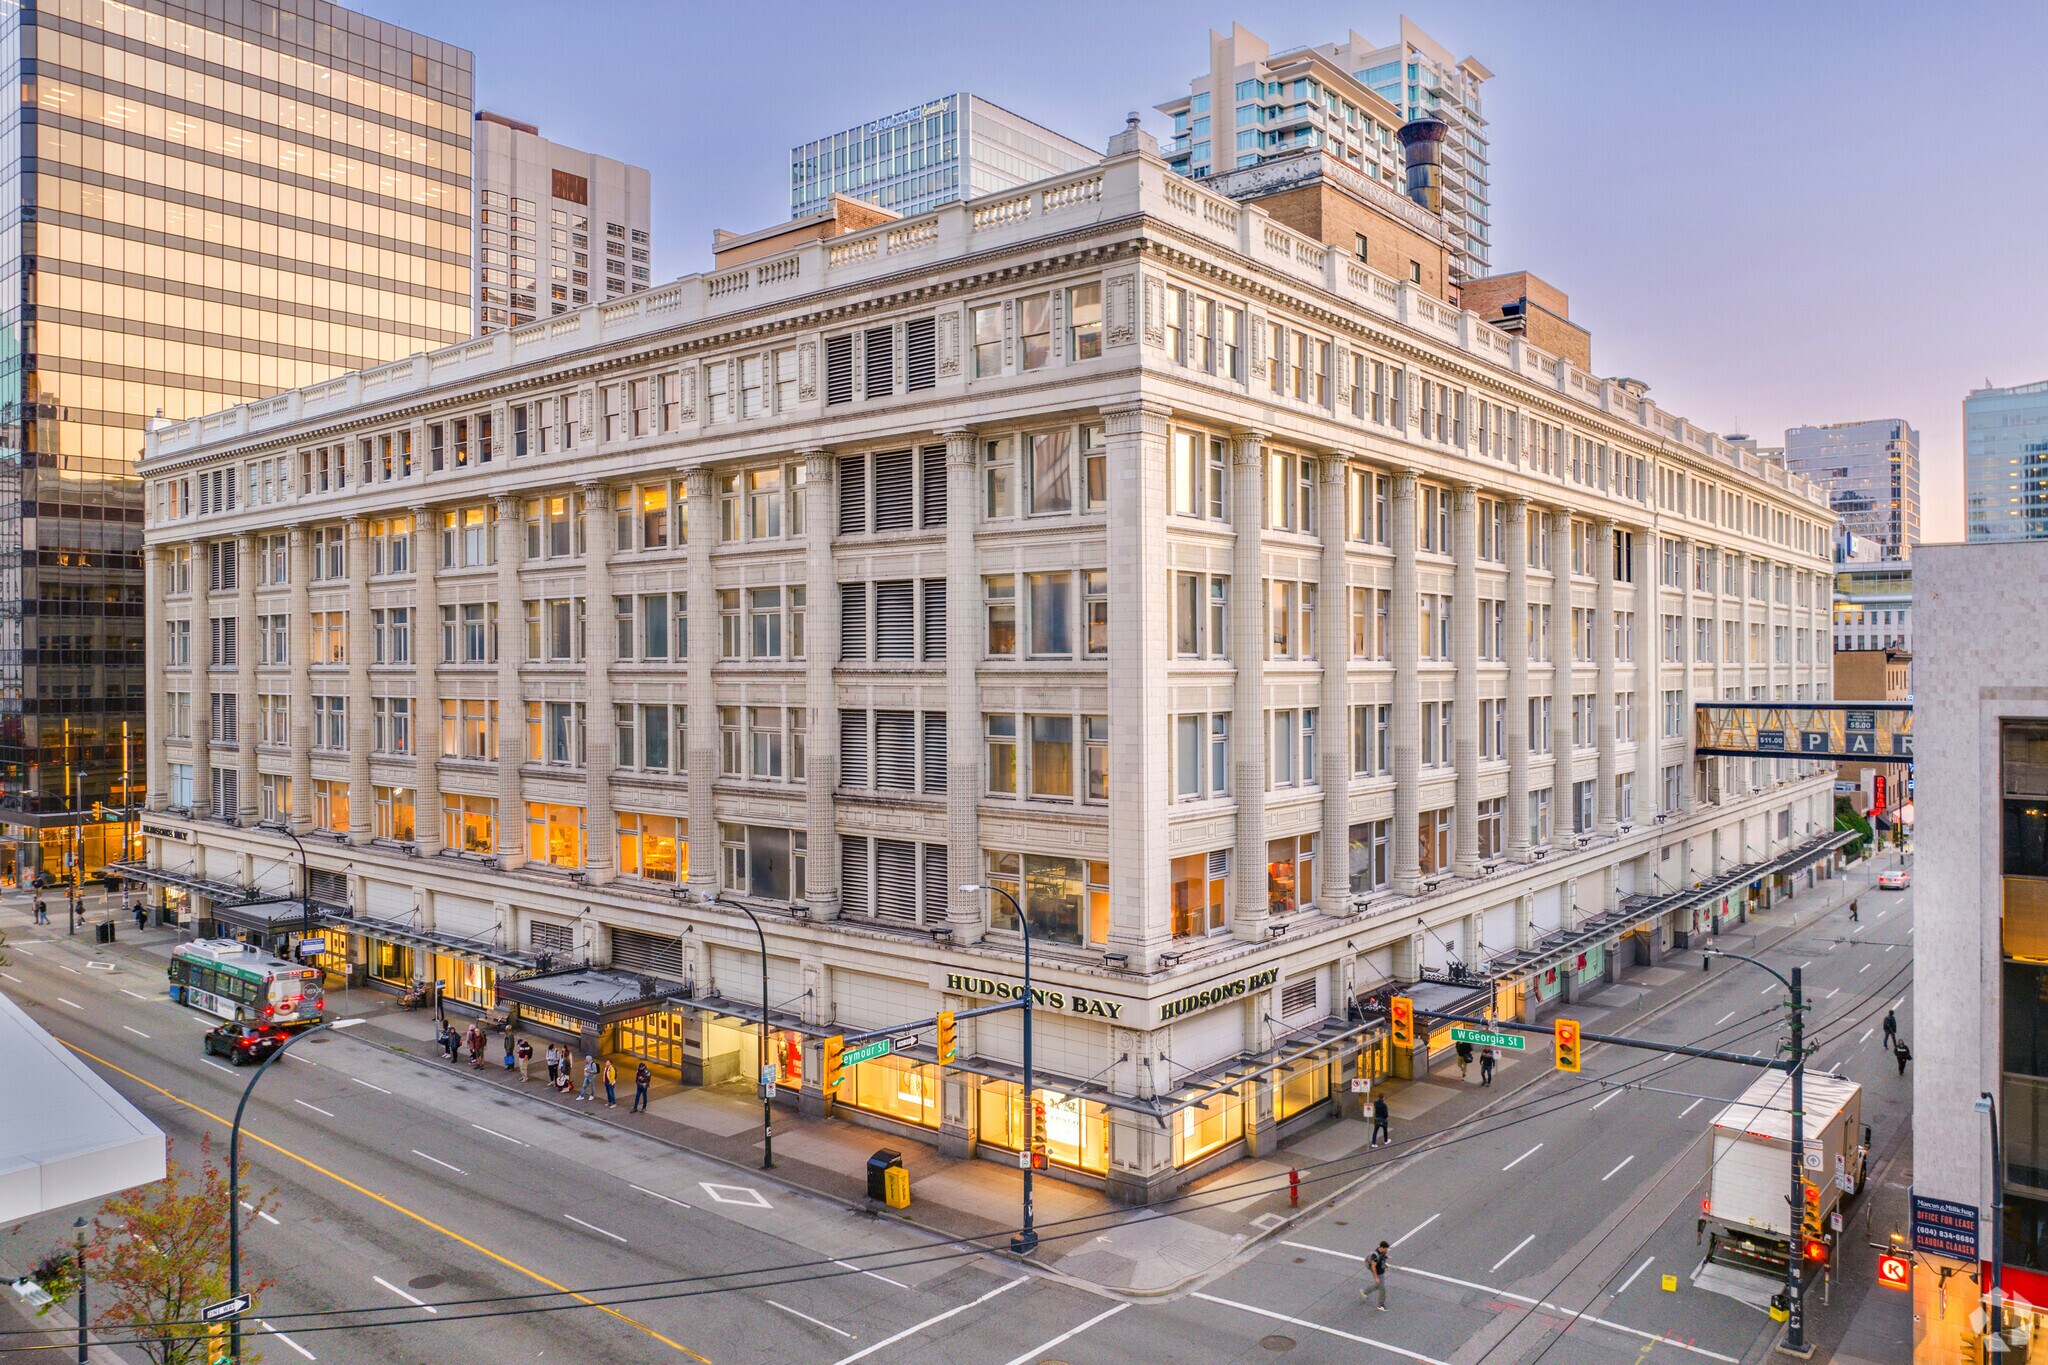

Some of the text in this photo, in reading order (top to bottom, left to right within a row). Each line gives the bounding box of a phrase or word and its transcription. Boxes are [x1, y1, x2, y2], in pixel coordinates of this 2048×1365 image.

[947, 974, 1123, 1019] HUDSON'S BAY
[1160, 967, 1279, 1021] HUDSON'S BAY
[1458, 1030, 1518, 1046] W Georgia St
[843, 1042, 886, 1064] eymour St
[1917, 1200, 1940, 1209] Marcus
[1946, 1204, 1974, 1217] Millichap
[1917, 1210, 1974, 1230] OFFICE FOR LEASE
[1917, 1226, 1974, 1244] (604) 834-6680
[1917, 1236, 1944, 1248] CLAUDIA
[1946, 1241, 1974, 1256] CLAASEN
[1888, 1263, 1902, 1279] K
